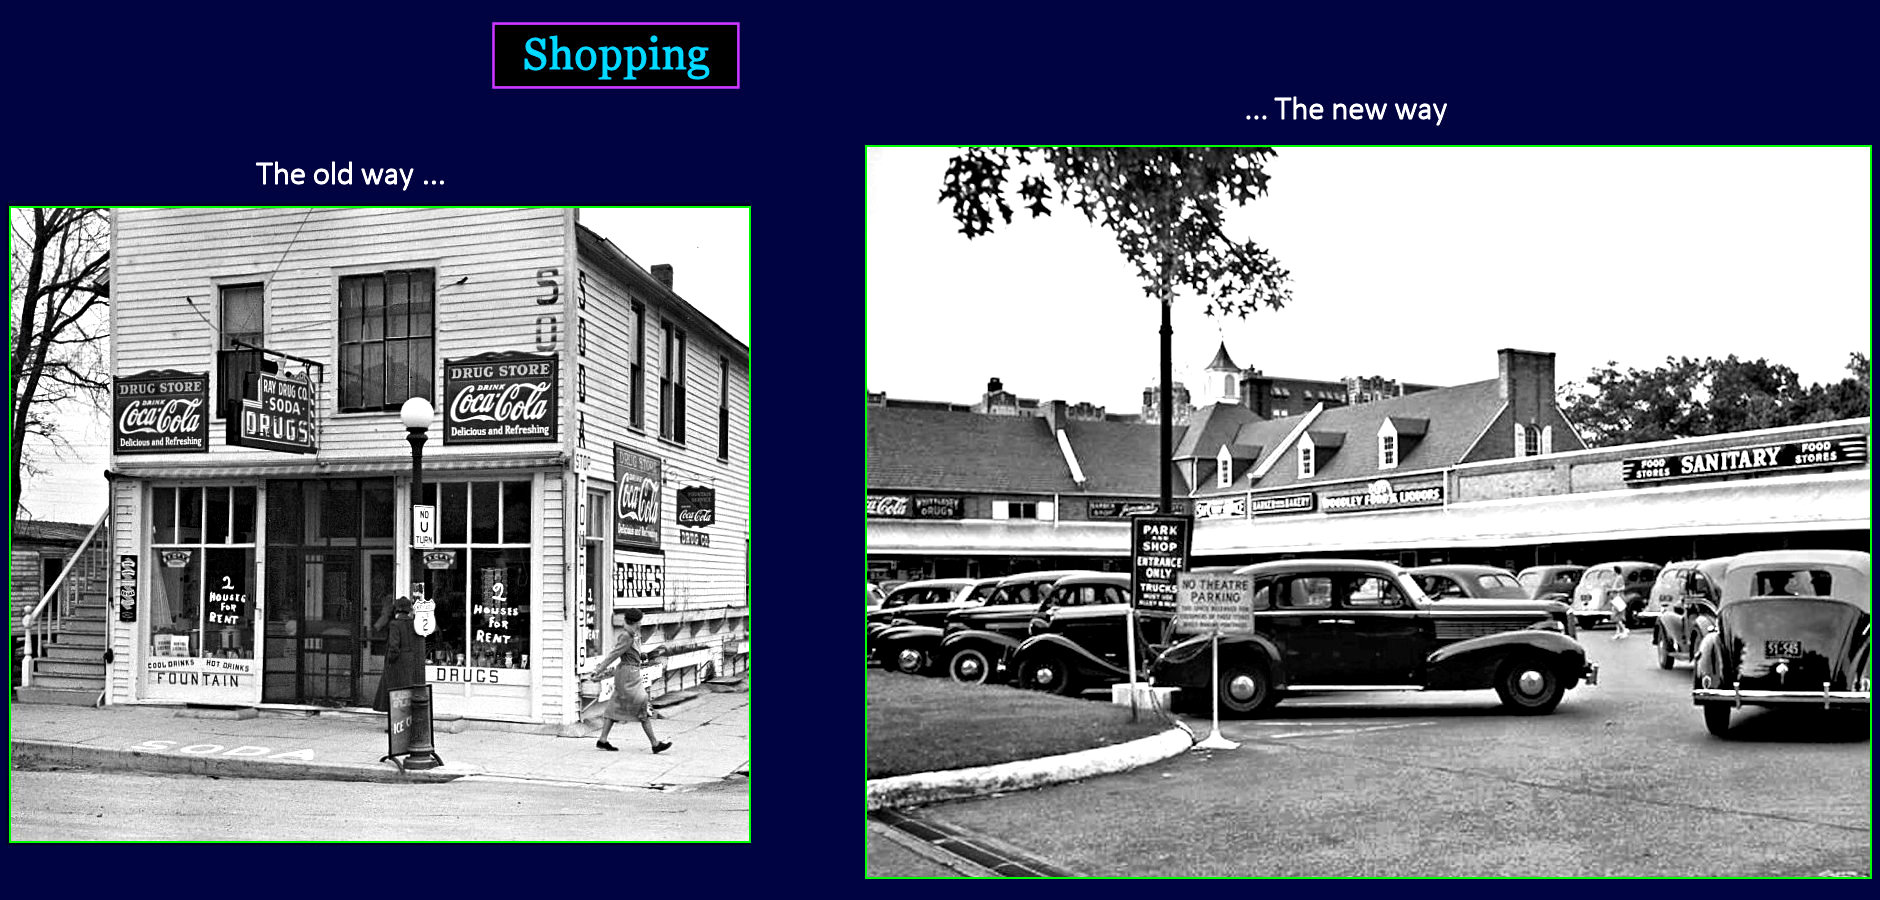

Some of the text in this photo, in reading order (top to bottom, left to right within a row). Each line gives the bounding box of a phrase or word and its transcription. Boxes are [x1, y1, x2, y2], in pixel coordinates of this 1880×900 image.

[451, 364, 550, 379] DRUG STORE
[120, 381, 202, 395] DRUG STORE
[263, 380, 276, 394] RAY
[278, 382, 296, 398] DRUG
[269, 398, 301, 415] SODA
[246, 411, 308, 443] DRUGS
[451, 425, 549, 436] Delicious and Refreshing
[120, 437, 202, 447] Delicious and Refreshing
[1801, 441, 1832, 452] FOOD
[1641, 458, 1666, 469] FOOD
[1681, 446, 1781, 474] SANITARY
[1794, 451, 1838, 464] STORES
[1636, 467, 1670, 478] STORES
[420, 511, 429, 519] NO
[420, 521, 429, 533] U
[1143, 525, 1178, 535] PARK
[416, 535, 433, 544] TURN
[1142, 541, 1178, 551] SHOP
[1137, 556, 1182, 568] ENTRANCE
[1145, 567, 1172, 578] ONLY
[221, 575, 235, 590] 2
[616, 562, 663, 598] DRUGS
[1182, 580, 1248, 590] NO THEATRE
[491, 582, 506, 601] 2
[1140, 583, 1178, 593] TRUCKS
[1191, 591, 1241, 602] PARKING
[209, 612, 239, 625] RENT
[422, 618, 429, 631] 2
[476, 629, 511, 644] RENT
[168, 659, 195, 668] DRINKS
[206, 659, 250, 672] HOT DRINKS
[157, 672, 239, 687] FOUNTAIN
[437, 667, 499, 684] DRUGS
[393, 720, 405, 734] ICE
[131, 740, 315, 761] SODA
